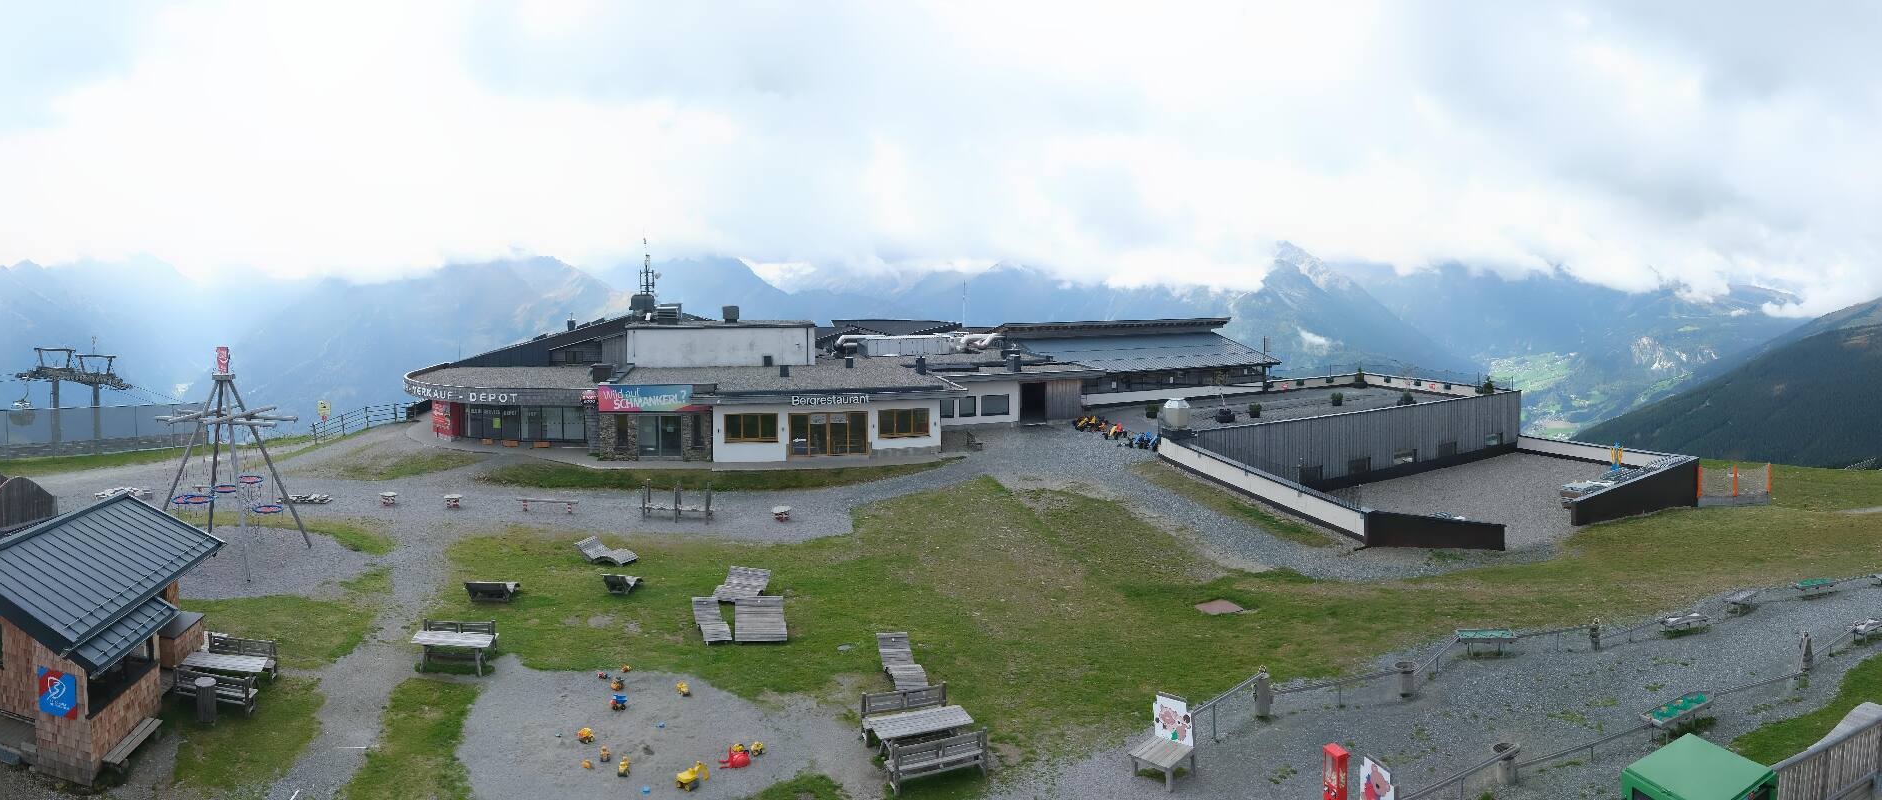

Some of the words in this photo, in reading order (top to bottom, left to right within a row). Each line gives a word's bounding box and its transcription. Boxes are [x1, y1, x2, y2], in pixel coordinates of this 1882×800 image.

[412, 385, 453, 400] VERKAUF
[469, 392, 518, 403] DEPOT
[603, 388, 624, 400] Wild
[625, 387, 641, 397] auf
[613, 390, 687, 410] SCHMANKERL?
[791, 394, 870, 407] Bergrestaurant
